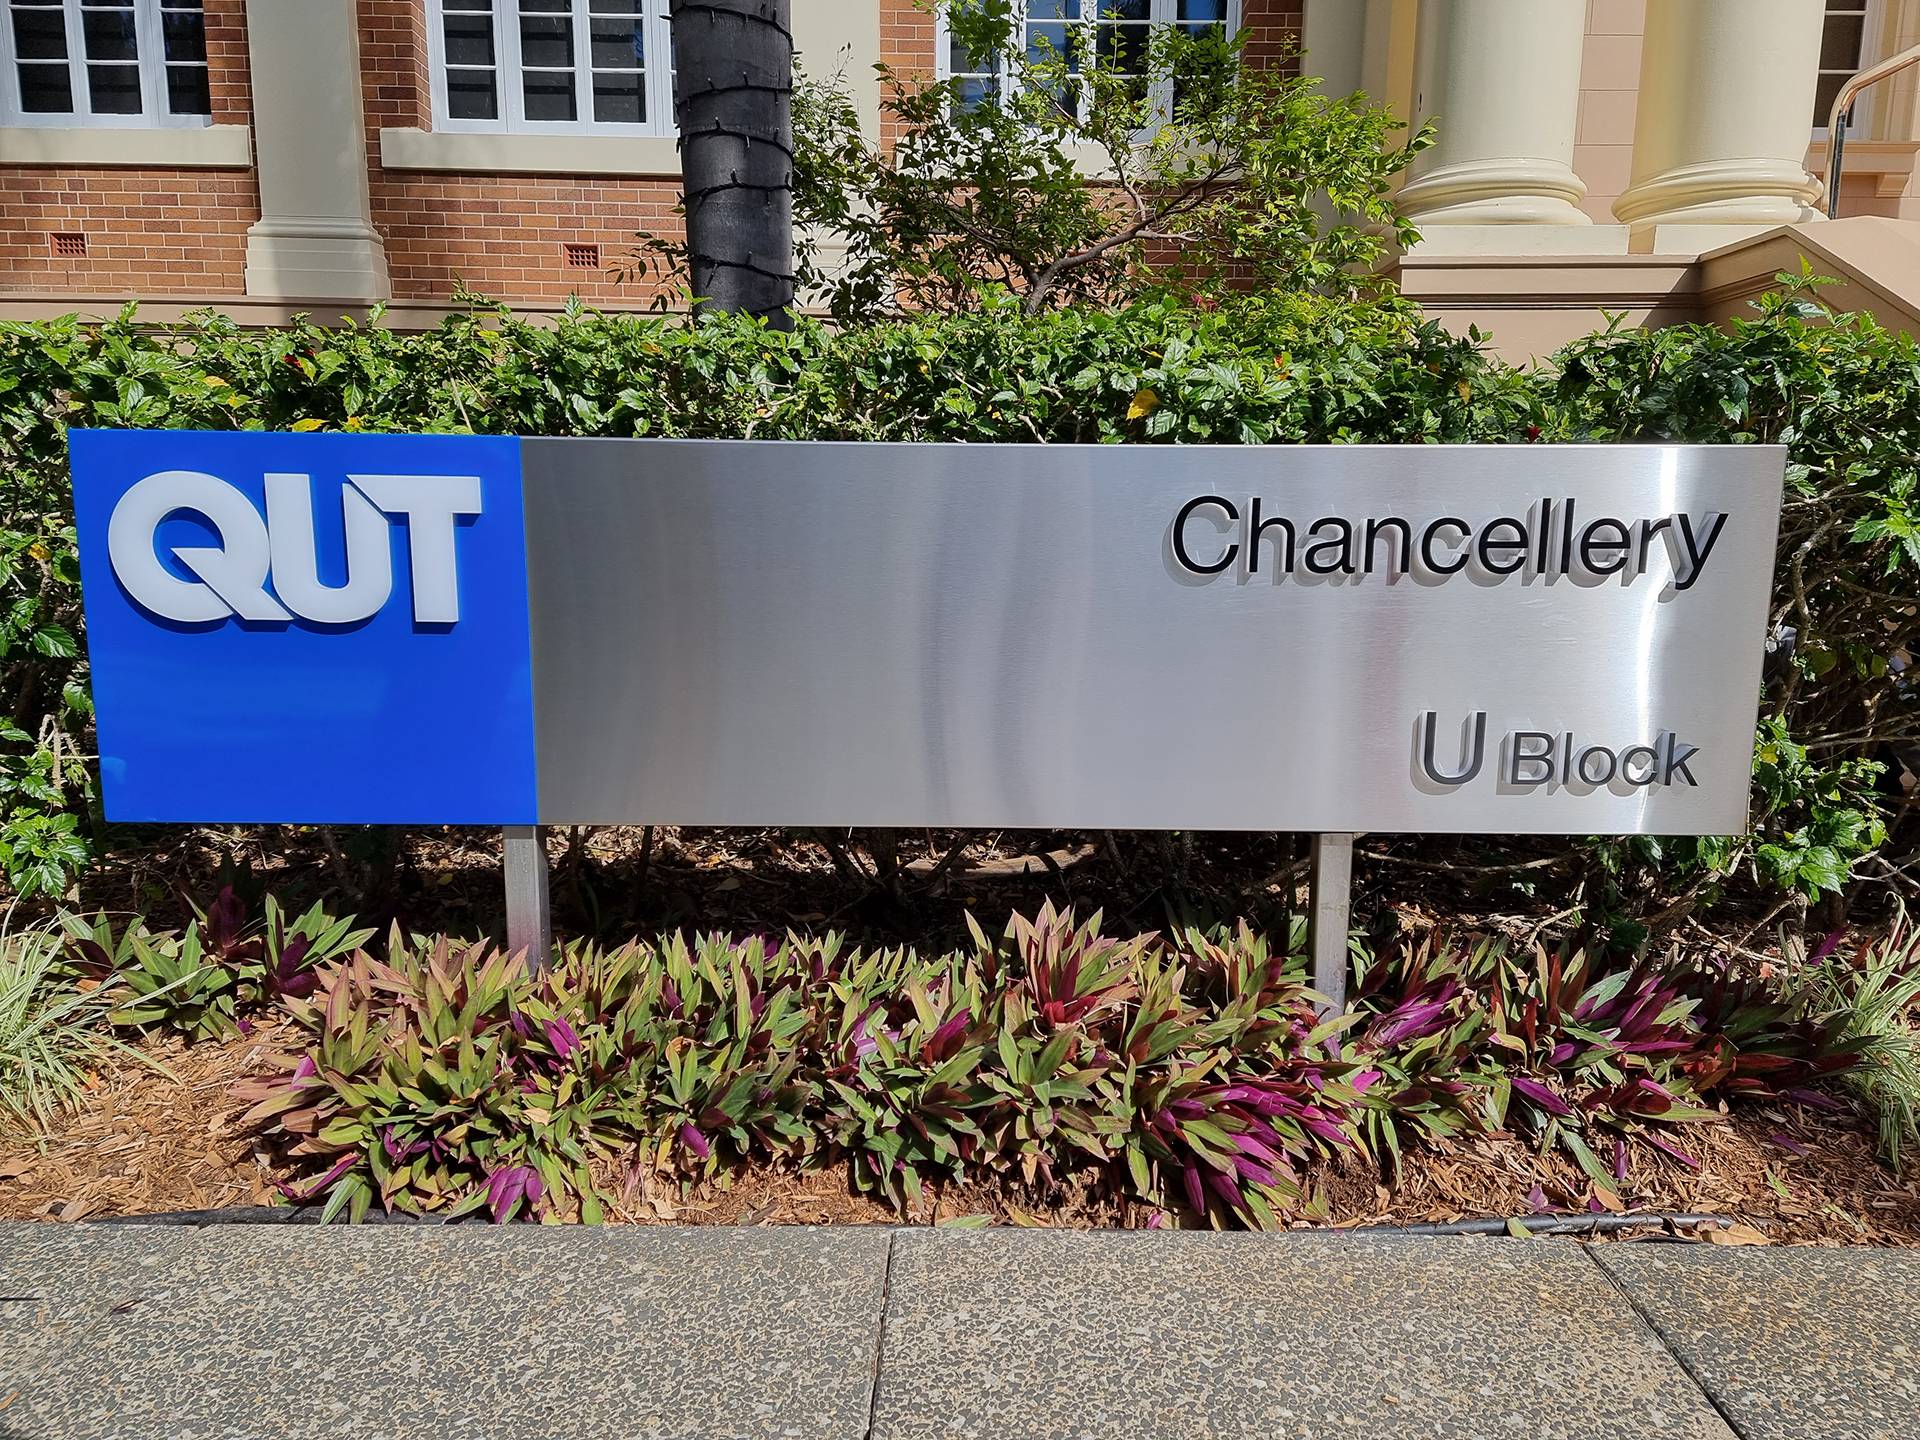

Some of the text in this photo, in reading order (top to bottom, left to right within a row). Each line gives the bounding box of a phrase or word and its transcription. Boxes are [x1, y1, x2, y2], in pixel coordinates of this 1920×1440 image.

[108, 470, 482, 623] QUT
[1171, 495, 1729, 591] Chancellery
[1422, 711, 1700, 787] U Block
